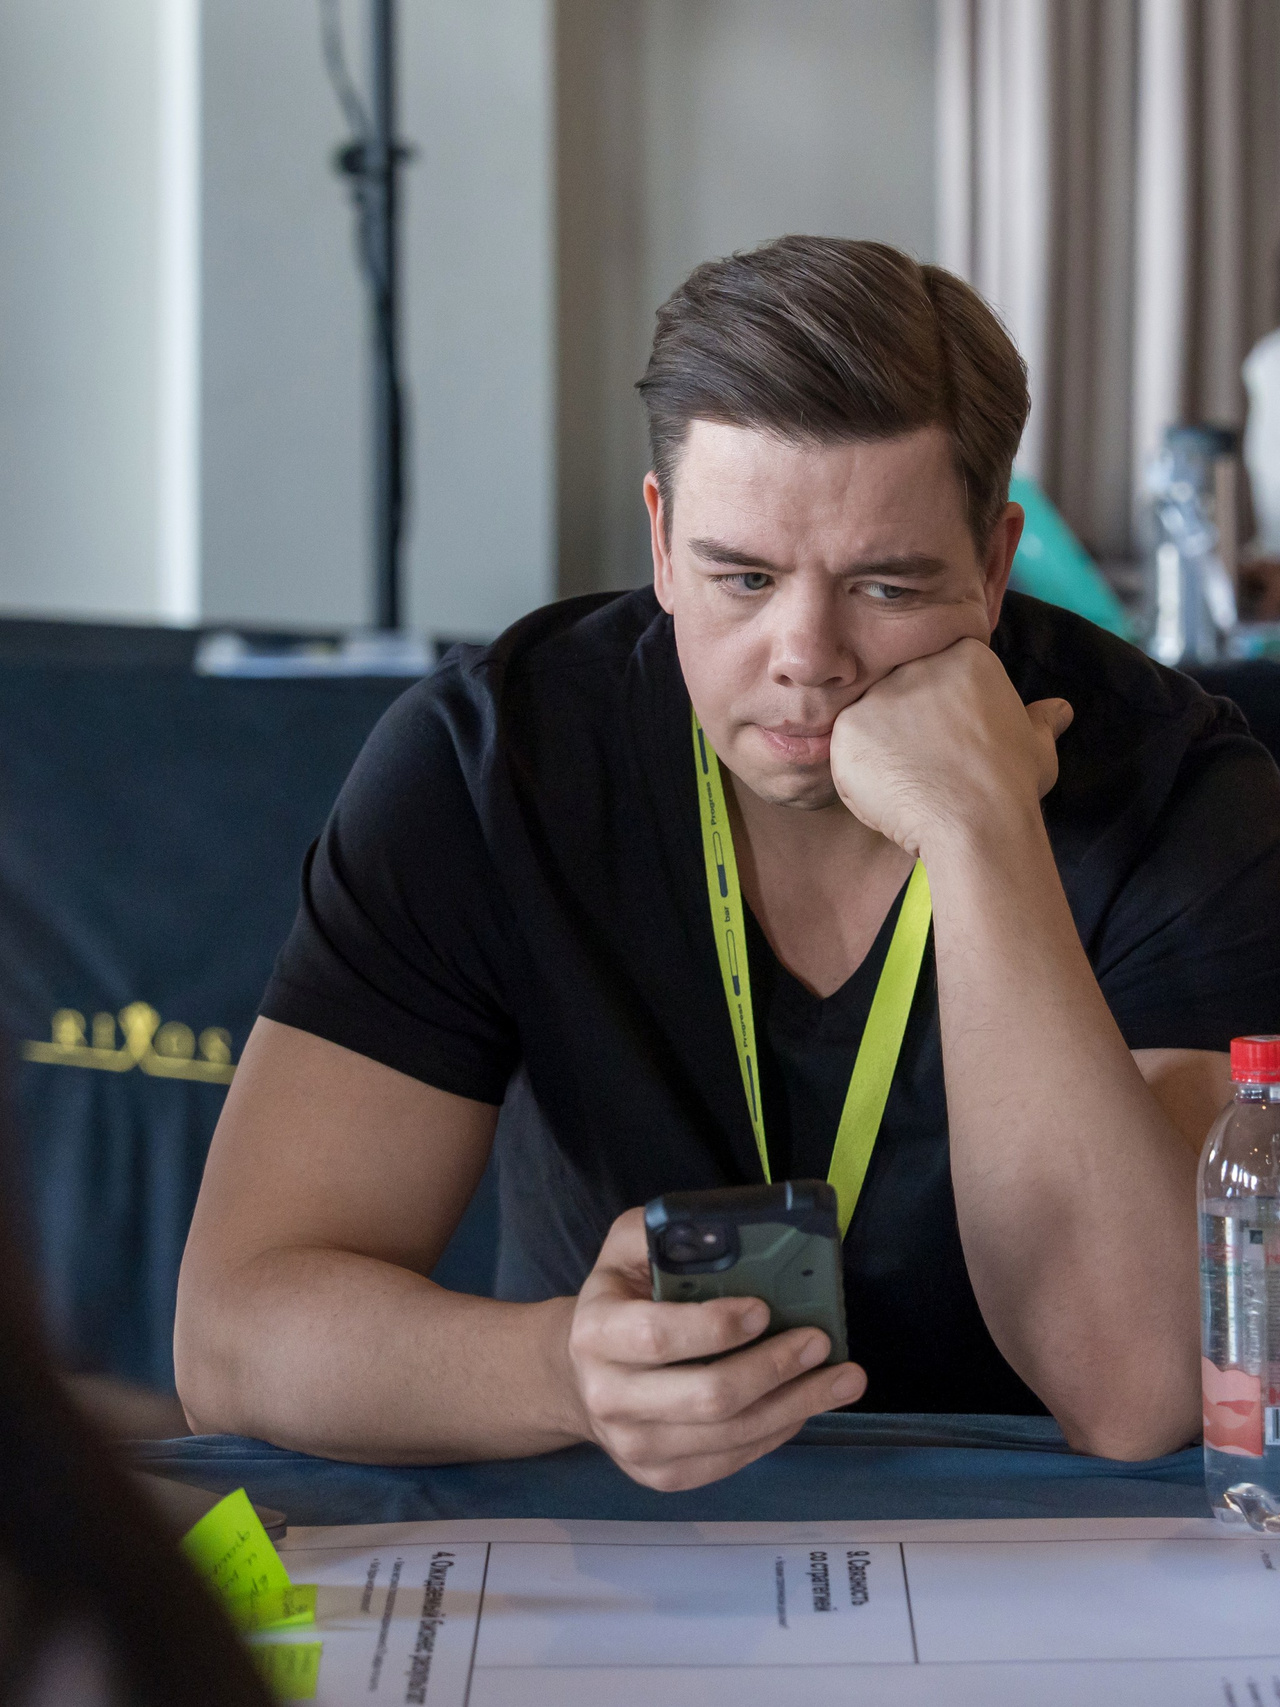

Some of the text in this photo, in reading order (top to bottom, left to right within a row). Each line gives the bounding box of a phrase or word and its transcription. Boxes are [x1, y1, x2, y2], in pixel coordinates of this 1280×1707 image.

[706, 781, 717, 826] Progress
[737, 1003, 748, 1048] Progress
[432, 1551, 456, 1559] 4.
[805, 1551, 838, 1612] со стратегией
[846, 1550, 871, 1606] 9. Связность
